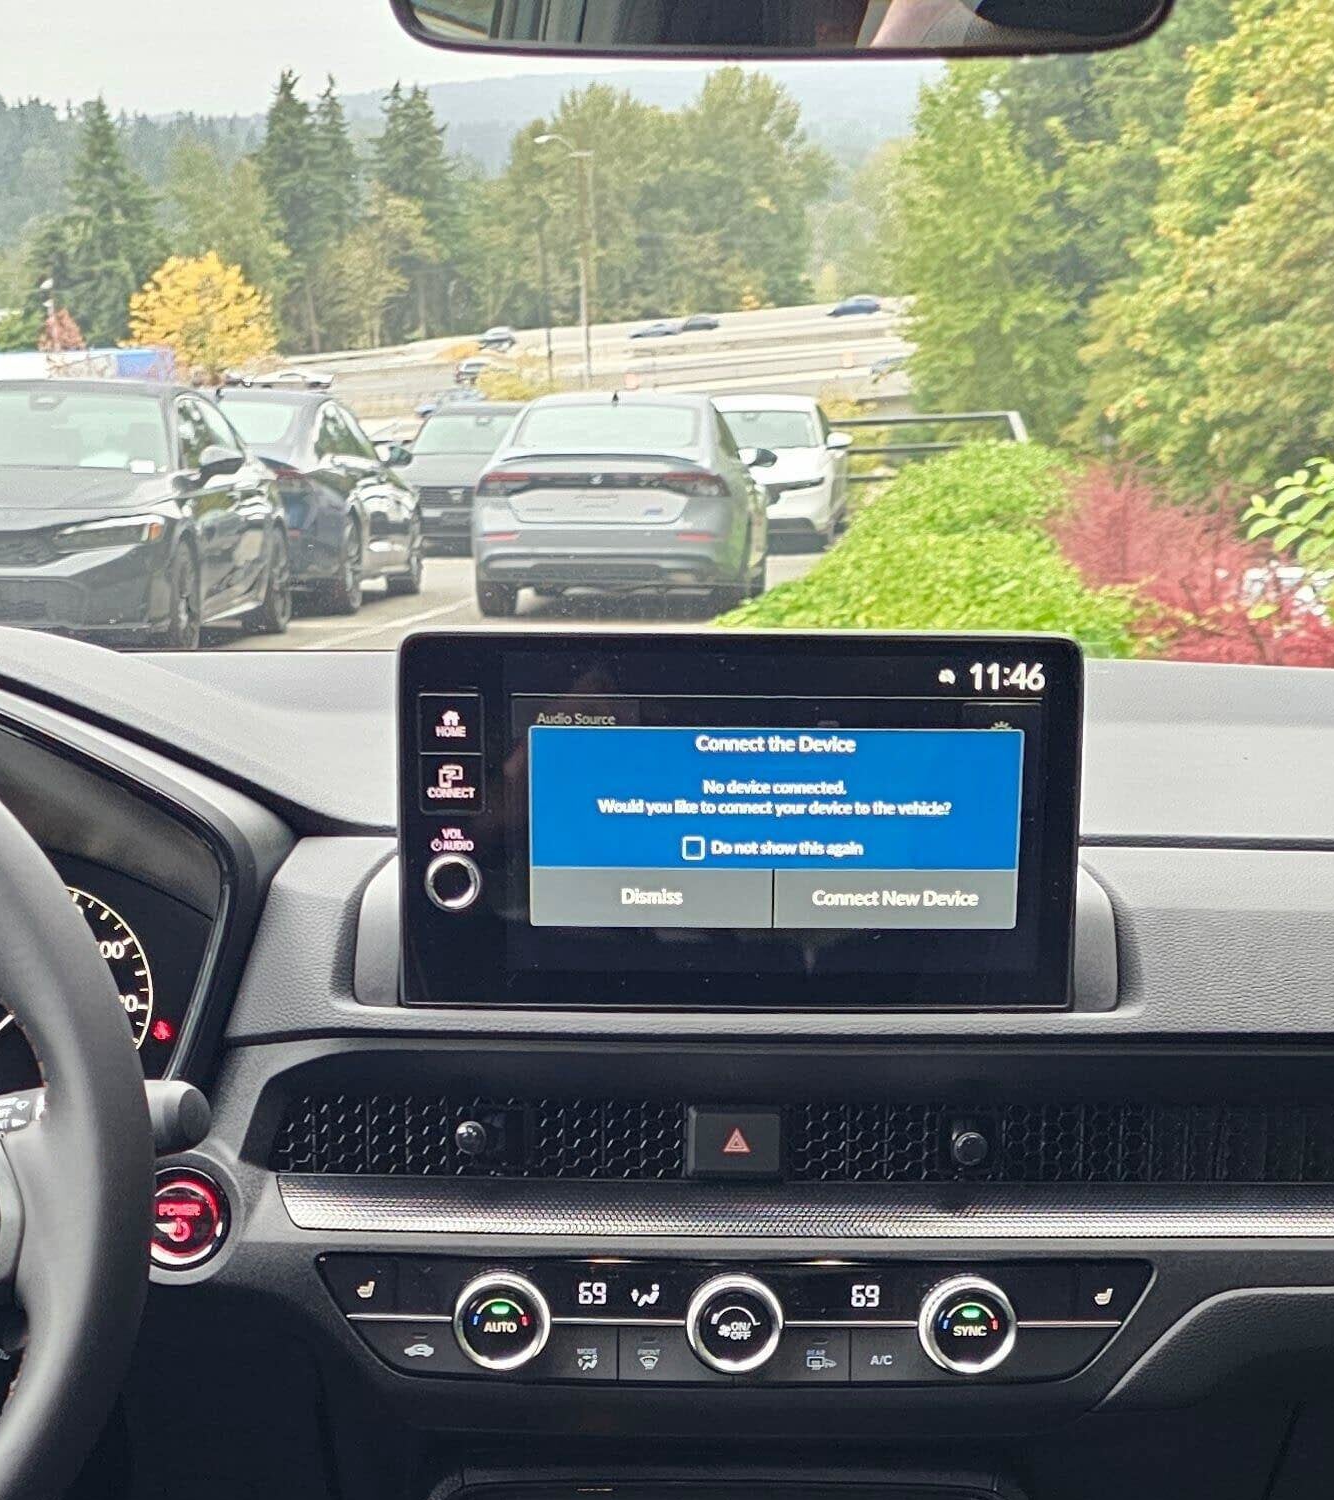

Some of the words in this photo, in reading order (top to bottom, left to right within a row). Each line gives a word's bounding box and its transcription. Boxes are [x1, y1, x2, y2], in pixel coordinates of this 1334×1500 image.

[968, 662, 1046, 691] 11:46
[536, 712, 572, 725] Audio
[574, 712, 616, 725] Source
[435, 725, 466, 738] HOME
[695, 735, 765, 753] Connect
[768, 736, 795, 753] the
[799, 736, 856, 754] Device
[427, 787, 475, 799] CONNECT
[703, 779, 724, 795] No
[726, 779, 770, 795] device
[772, 780, 847, 796] connected.
[597, 798, 644, 814] Would
[646, 802, 673, 816] you
[674, 798, 698, 814] like
[700, 800, 716, 815] to
[718, 800, 773, 815] connect
[775, 803, 806, 818] your
[808, 801, 853, 816] device
[854, 802, 870, 816] to
[872, 801, 895, 816] the
[897, 801, 952, 817] vehicle?
[441, 828, 464, 840] VOL
[443, 840, 474, 852] AUDIO
[711, 841, 732, 856] Do
[734, 842, 759, 856] not
[760, 842, 797, 856] show
[799, 842, 824, 856] this
[826, 843, 864, 858] again
[621, 888, 683, 905] Dismiss
[812, 889, 880, 907] Connect
[882, 890, 920, 907] New
[923, 890, 979, 908] Device
[99, 941, 125, 959] 00
[158, 1203, 201, 1216] POWER
[577, 1281, 607, 1305] 69
[850, 1284, 880, 1308] 69
[483, 1321, 517, 1333] AUTO
[730, 1321, 752, 1332] ON/
[952, 1325, 988, 1338] SYNC
[730, 1330, 752, 1341] OFF
[870, 1354, 893, 1366] A/C
